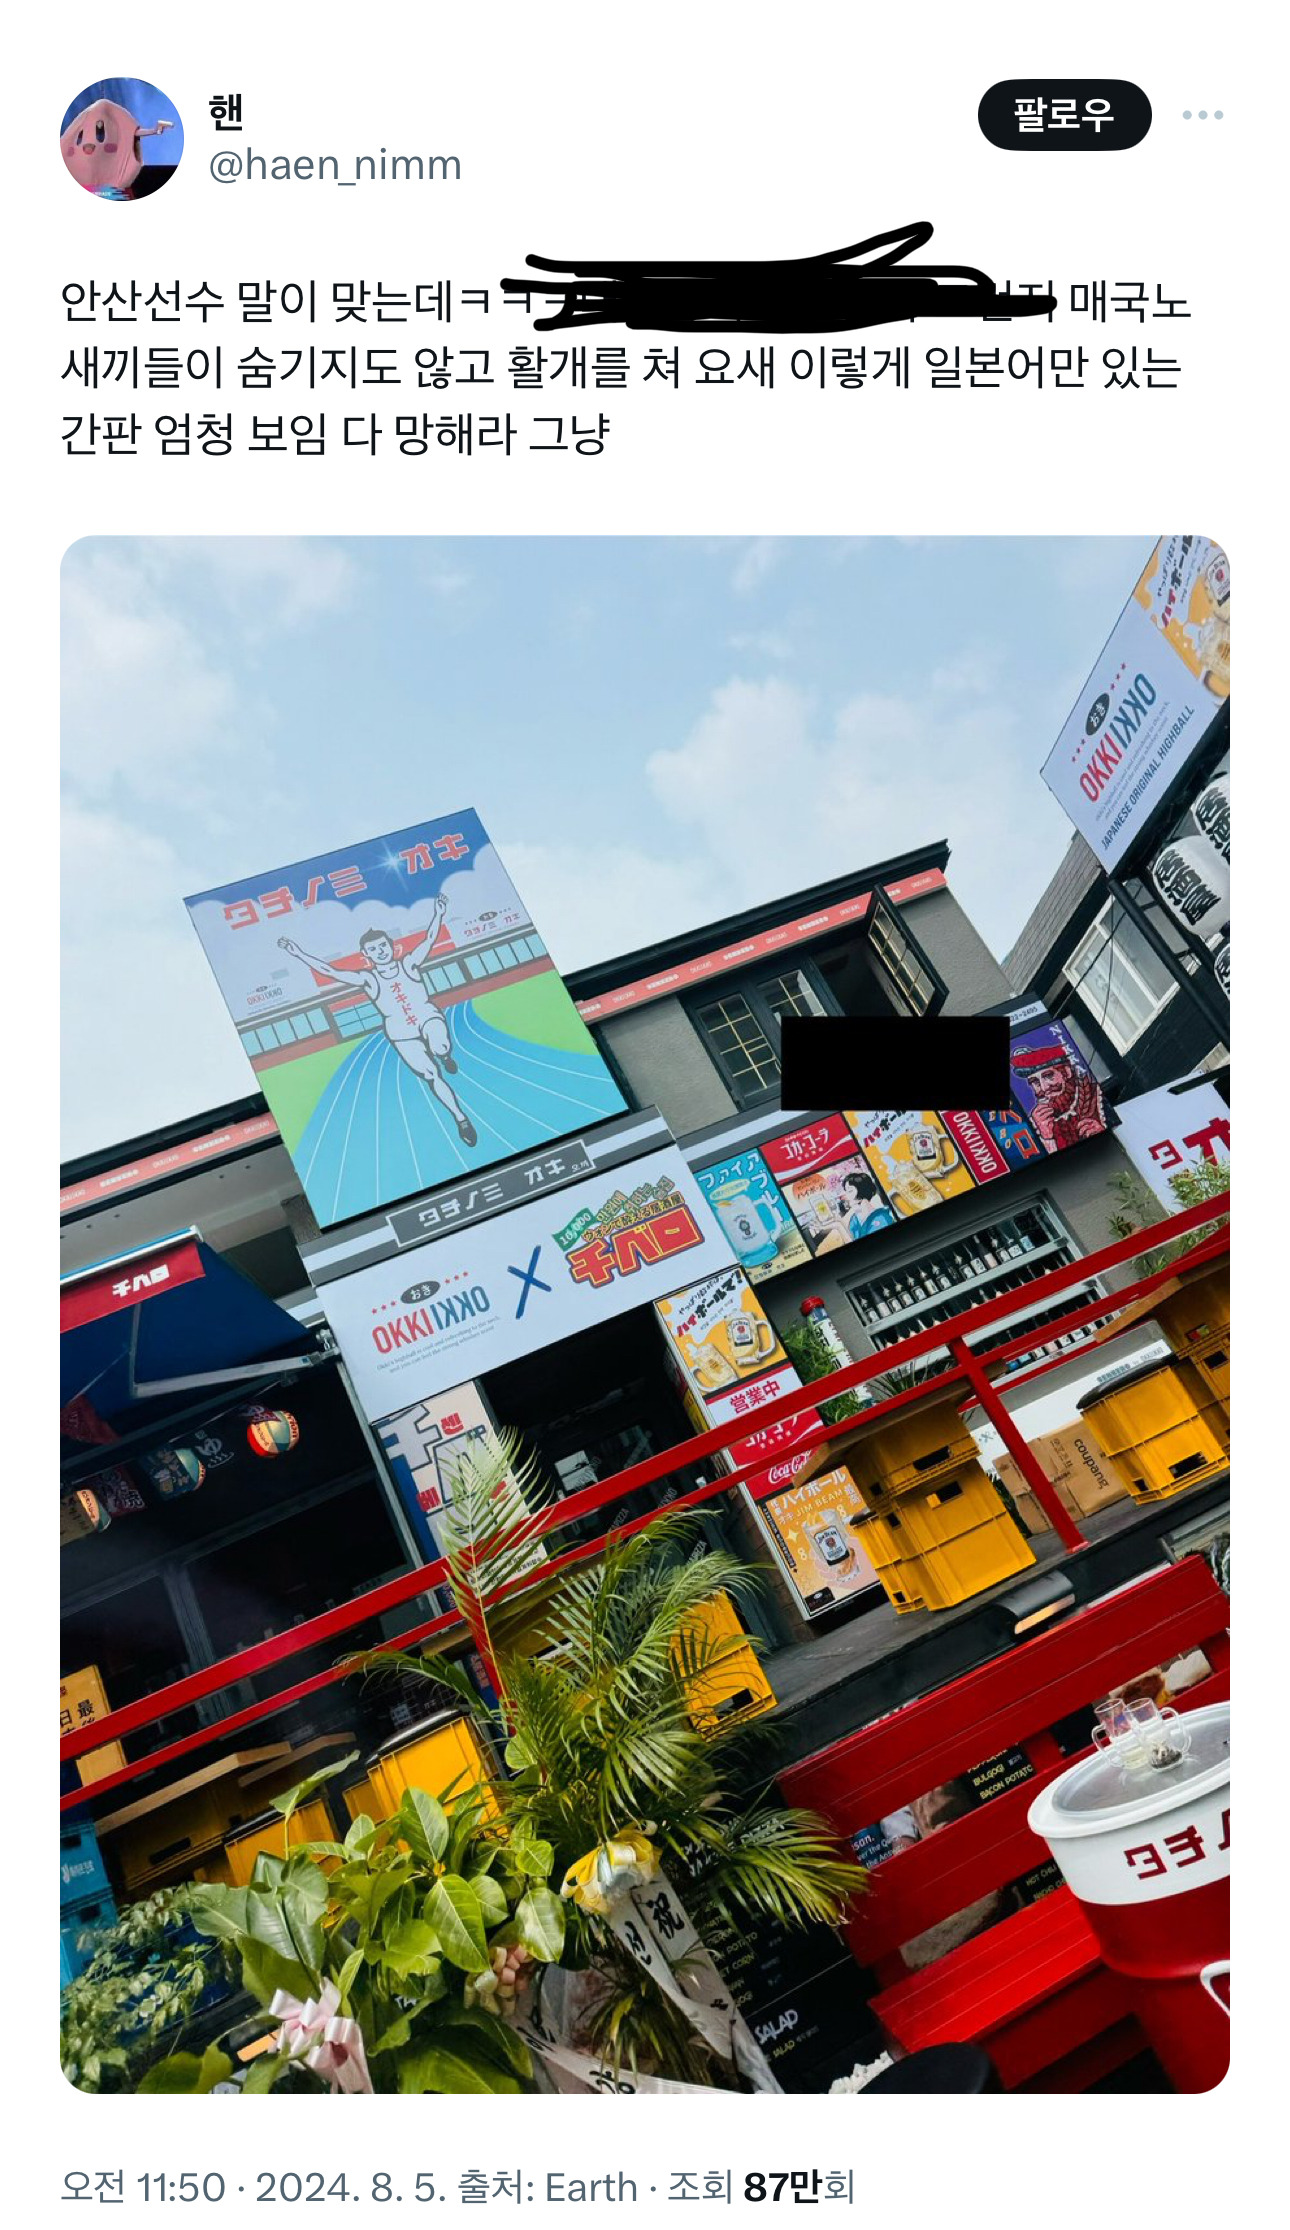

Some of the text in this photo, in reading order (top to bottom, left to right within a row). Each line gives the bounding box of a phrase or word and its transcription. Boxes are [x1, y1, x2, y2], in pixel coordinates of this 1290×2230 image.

[1102, 706, 1195, 850] JAPANESE ORIGINAL HIGHBALL
[400, 833, 469, 875] オキ
[1049, 1025, 1087, 1077] NIKKA
[523, 1159, 566, 1186] オキ
[729, 1379, 781, 1414] 営業中
[1074, 1438, 1109, 1490] coupang
[782, 1468, 847, 1511] ハイボール
[796, 1503, 814, 1518] JIM
[813, 1489, 844, 1512] BEAM
[972, 1763, 1005, 1786] BULGOGI
[650, 1893, 685, 1940] 祝
[754, 2009, 798, 2046] SALAD
[773, 2040, 795, 2059] SALAD
